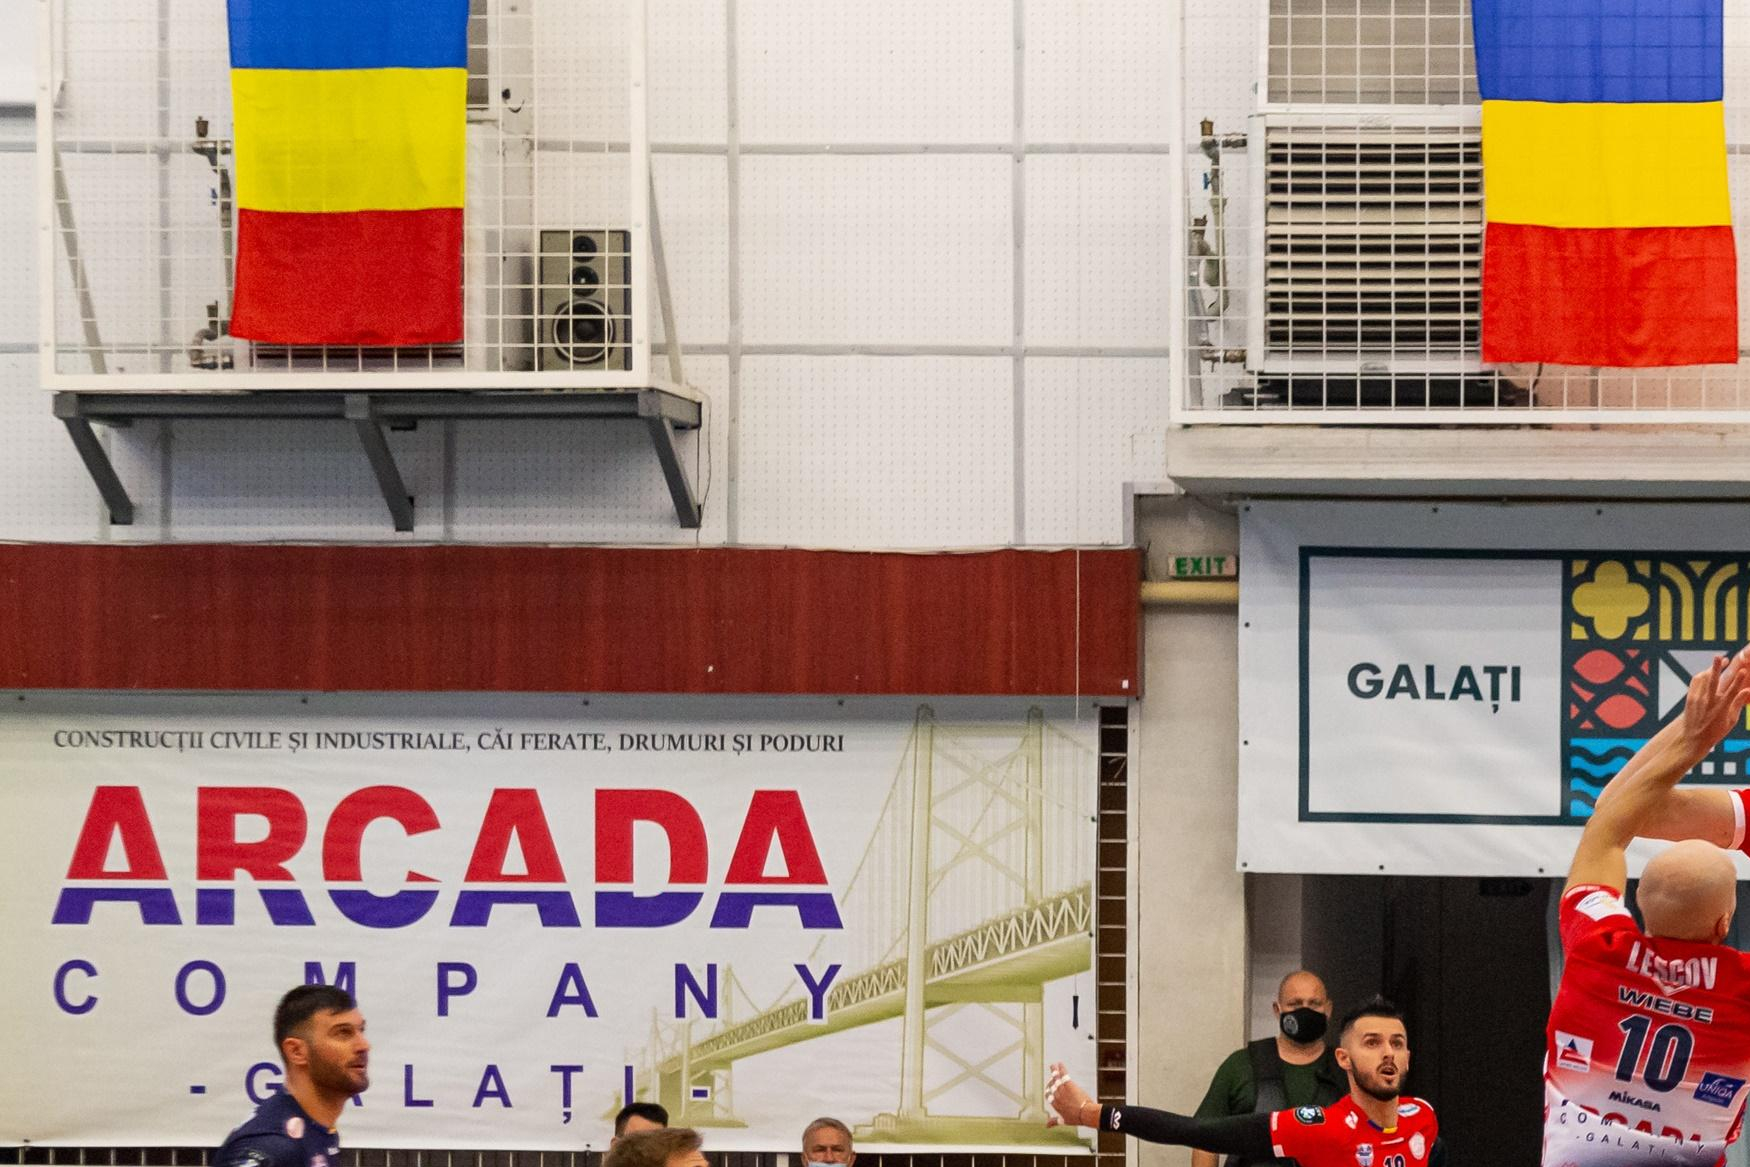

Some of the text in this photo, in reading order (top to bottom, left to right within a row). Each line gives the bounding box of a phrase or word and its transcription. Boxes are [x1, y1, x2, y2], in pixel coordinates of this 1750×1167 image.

[1175, 556, 1227, 577] EXIT
[1347, 662, 1521, 714] GALAȚI
[53, 728, 844, 756] CONSTRUCȚII CIVILE ȘI INDUSTRIALE, CĂI FERATE, DRUMURI ȘI PODURI
[51, 784, 845, 930] ARCADA
[1618, 984, 1715, 1024] WIEBE
[1616, 1013, 1696, 1093] 10
[1699, 1082, 1735, 1100] UNIQA
